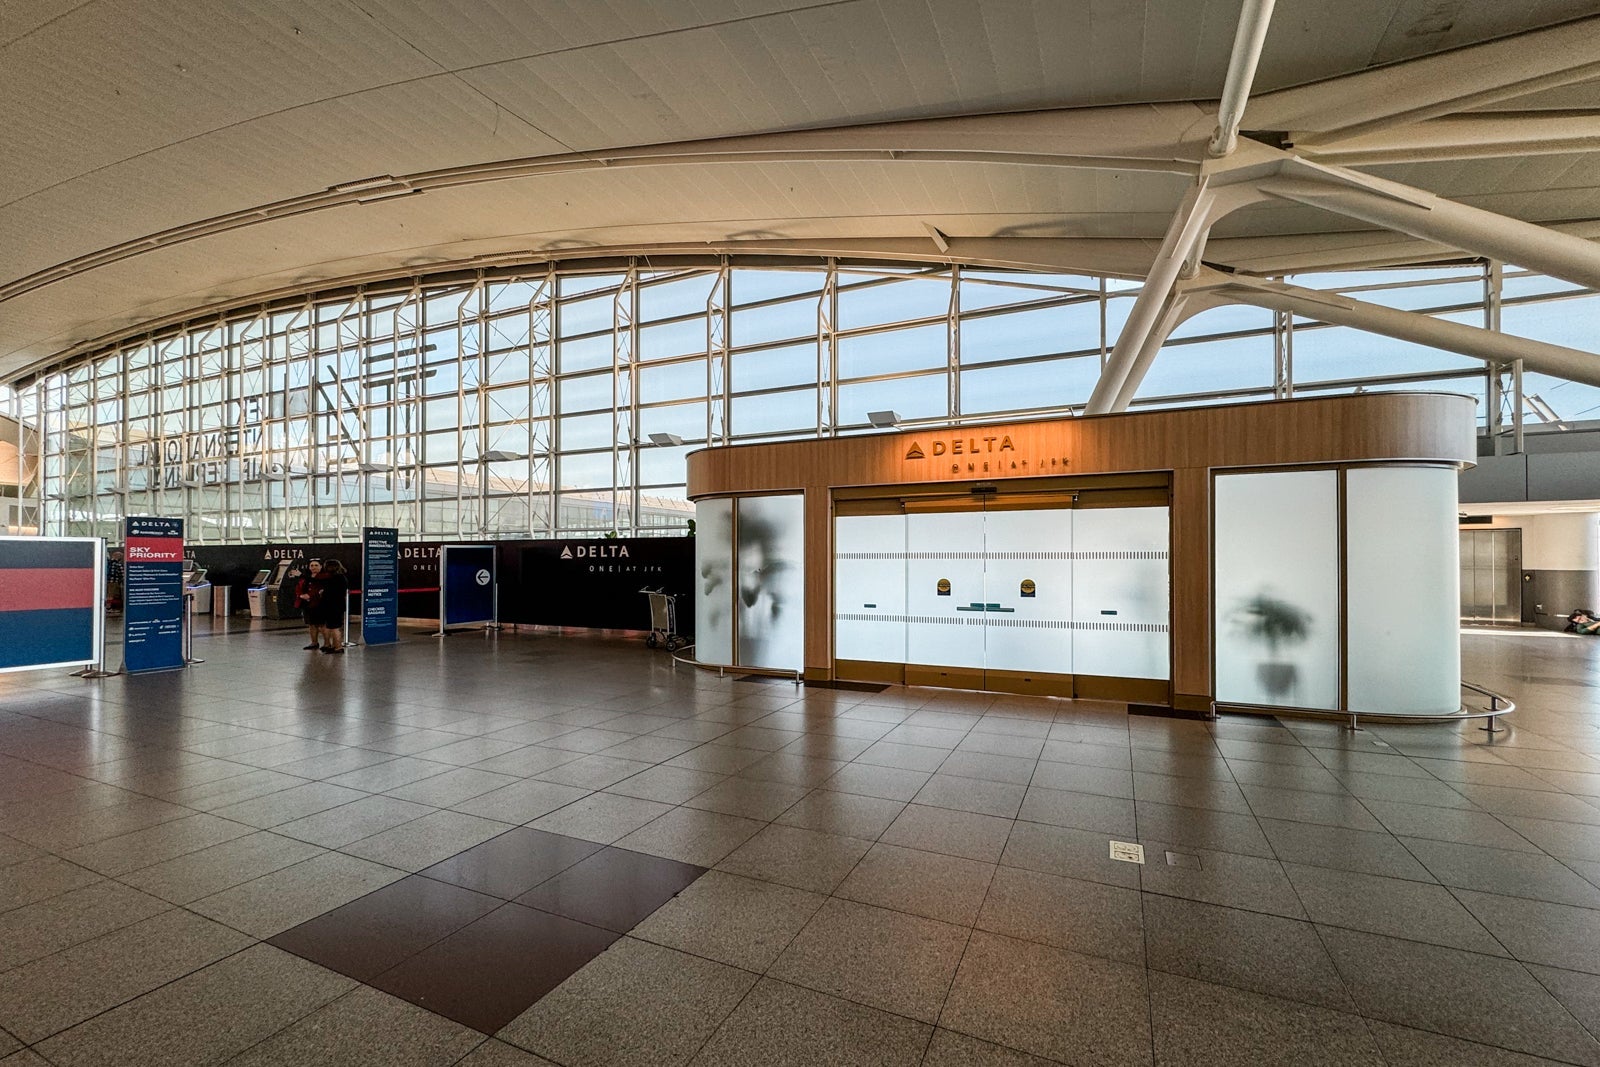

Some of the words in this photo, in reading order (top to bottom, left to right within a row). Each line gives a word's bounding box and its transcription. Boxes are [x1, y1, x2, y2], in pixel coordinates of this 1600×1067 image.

[932, 435, 1015, 456] DELTA
[951, 461, 989, 474] ONE
[273, 549, 304, 559] DELTA
[404, 547, 441, 558] DELTA
[576, 545, 630, 558] DELTA
